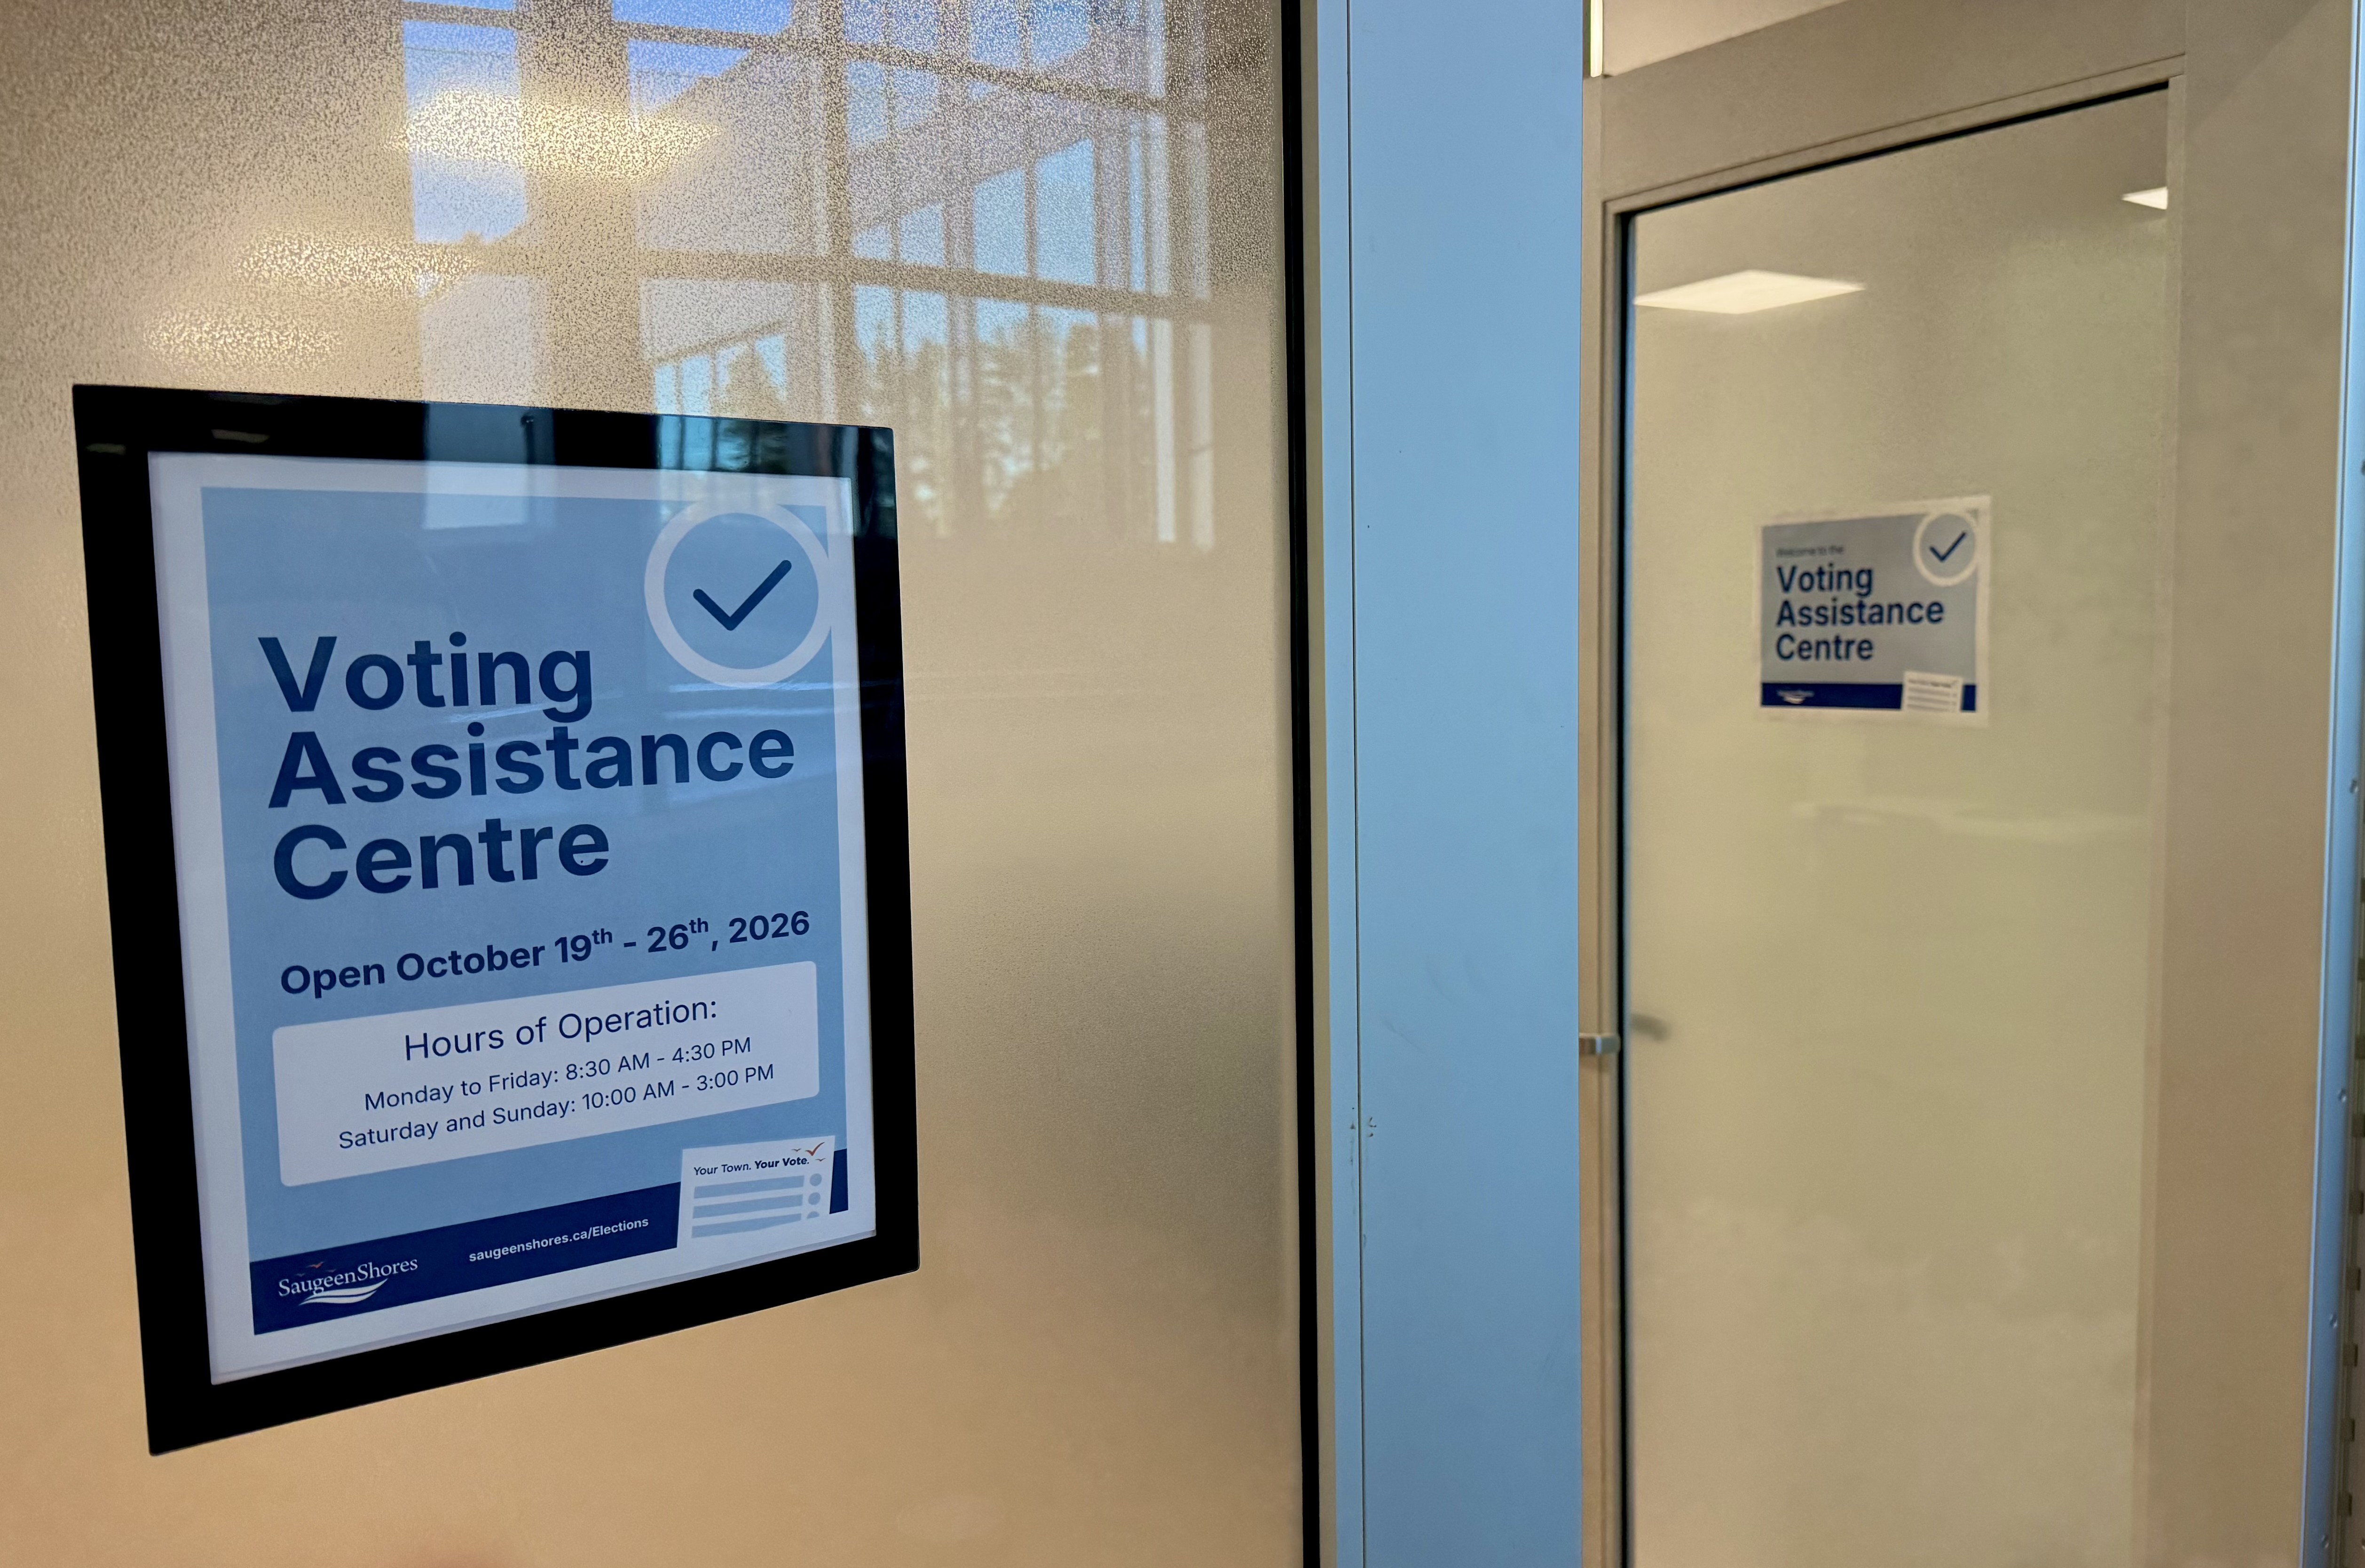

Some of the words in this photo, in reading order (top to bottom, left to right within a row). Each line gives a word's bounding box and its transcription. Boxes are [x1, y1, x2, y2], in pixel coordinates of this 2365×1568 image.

[1776, 563, 1873, 597] Voting
[1776, 597, 1944, 627] Assistance
[258, 631, 592, 723] Voting
[1776, 633, 1874, 661] Centre
[268, 721, 794, 809] Assistance
[274, 818, 609, 900] Centre
[281, 963, 385, 999] Open
[396, 945, 545, 981] October
[554, 928, 613, 963] 19th
[729, 911, 810, 943] 2026
[405, 1029, 504, 1061] Hours
[516, 1016, 547, 1045] of
[559, 1000, 716, 1043] Operation:
[339, 1121, 439, 1149] Saturday
[446, 1110, 485, 1132] and
[493, 1100, 575, 1125] Sunday:
[582, 1087, 636, 1110] 10:00
[643, 1079, 674, 1101] AM
[697, 1070, 739, 1091] 3:00
[745, 1064, 773, 1083] PM
[365, 1085, 454, 1111] Monday
[460, 1080, 481, 1096] to
[489, 1070, 558, 1092] Friday:
[566, 1058, 611, 1080] 8:30
[617, 1052, 649, 1073] AM
[671, 1042, 715, 1063] 4:30
[722, 1037, 750, 1056] PM
[694, 1166, 718, 1175] Your
[721, 1163, 751, 1173] Town.
[755, 1160, 780, 1169] Your
[782, 1157, 809, 1166] Vote.
[469, 1219, 649, 1262] saugeenshores.ca/Elections
